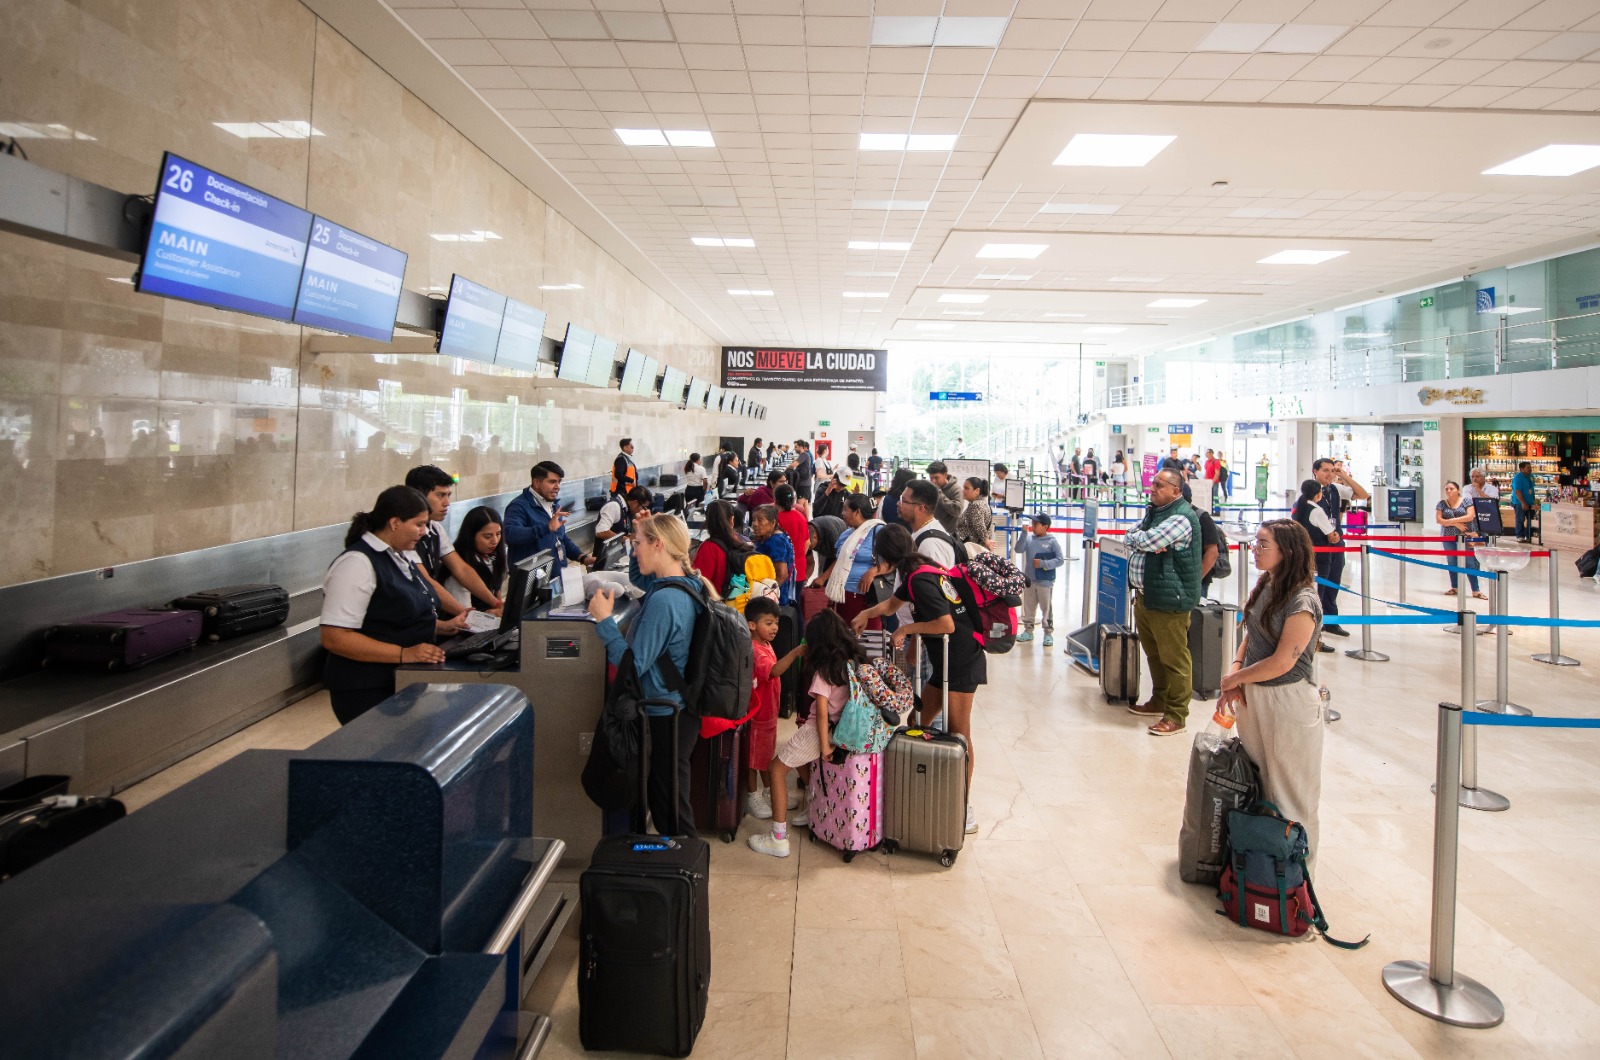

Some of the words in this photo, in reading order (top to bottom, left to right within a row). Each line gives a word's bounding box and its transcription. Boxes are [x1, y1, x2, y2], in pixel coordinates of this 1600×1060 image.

[166, 164, 194, 193] 26
[203, 190, 241, 213] Check-in
[206, 175, 269, 208] Documentación
[158, 230, 209, 257] MAIN
[313, 224, 331, 245] 25
[155, 248, 201, 267] Customer
[199, 259, 242, 279] Assistance
[306, 275, 338, 294] MAIN
[453, 280, 464, 296] 24
[448, 318, 466, 330] MAIN
[728, 351, 754, 367] NOS
[758, 352, 803, 368] MUEVE
[806, 352, 823, 370] LA
[826, 353, 876, 371] CIUDAD
[1210, 797, 1223, 853] patagonia
